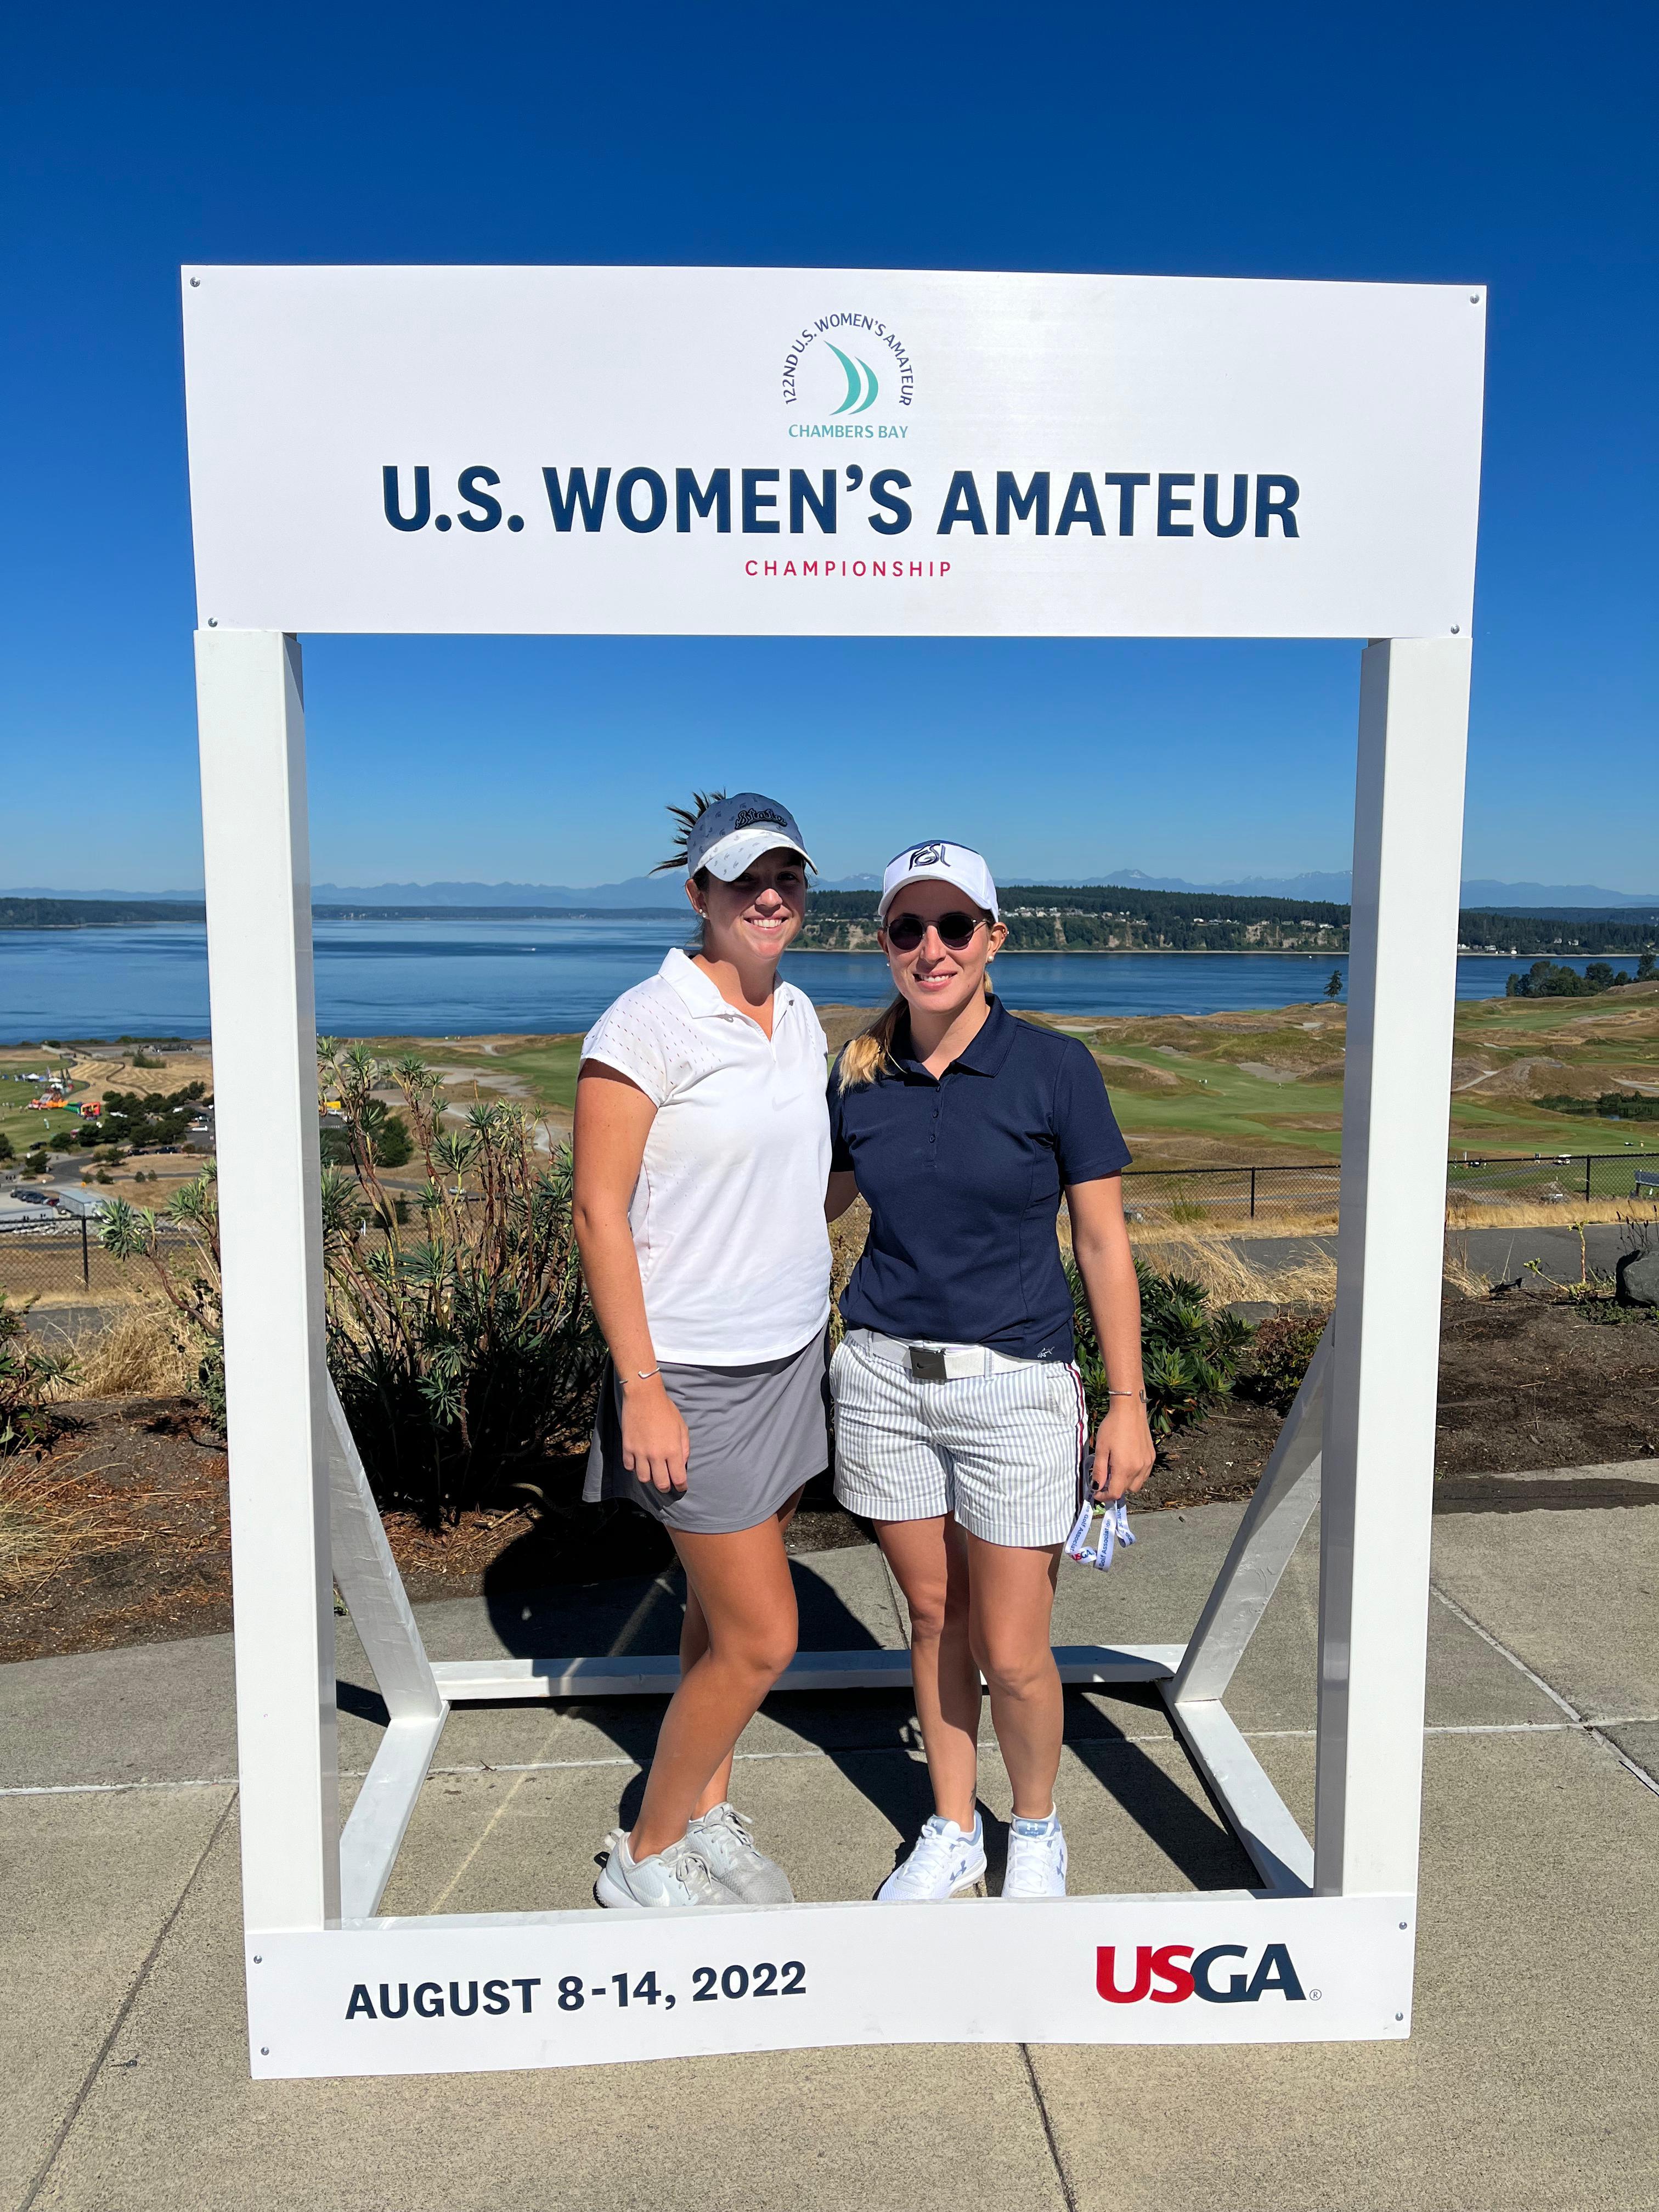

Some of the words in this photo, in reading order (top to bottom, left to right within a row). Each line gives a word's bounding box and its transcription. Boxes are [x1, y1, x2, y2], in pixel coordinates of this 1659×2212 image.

[782, 354, 798, 405] 122ND
[792, 329, 817, 353] U.S.
[814, 313, 887, 337] WOMEN'S
[882, 334, 913, 406] AMATEUR
[788, 424, 874, 438] CHAMBERS
[878, 425, 909, 438] BAY
[382, 465, 524, 533] U.S.
[541, 464, 912, 535] WOMEN'S
[936, 470, 1300, 538] AMATEUR
[745, 560, 951, 577] CHAMPIONSHIP
[1070, 1527, 1084, 1551] Associat
[1101, 1519, 1111, 1554] Association
[345, 1978, 541, 2020] AUGUST
[557, 1971, 676, 2011] 8-14,
[692, 1961, 806, 2002] 2022
